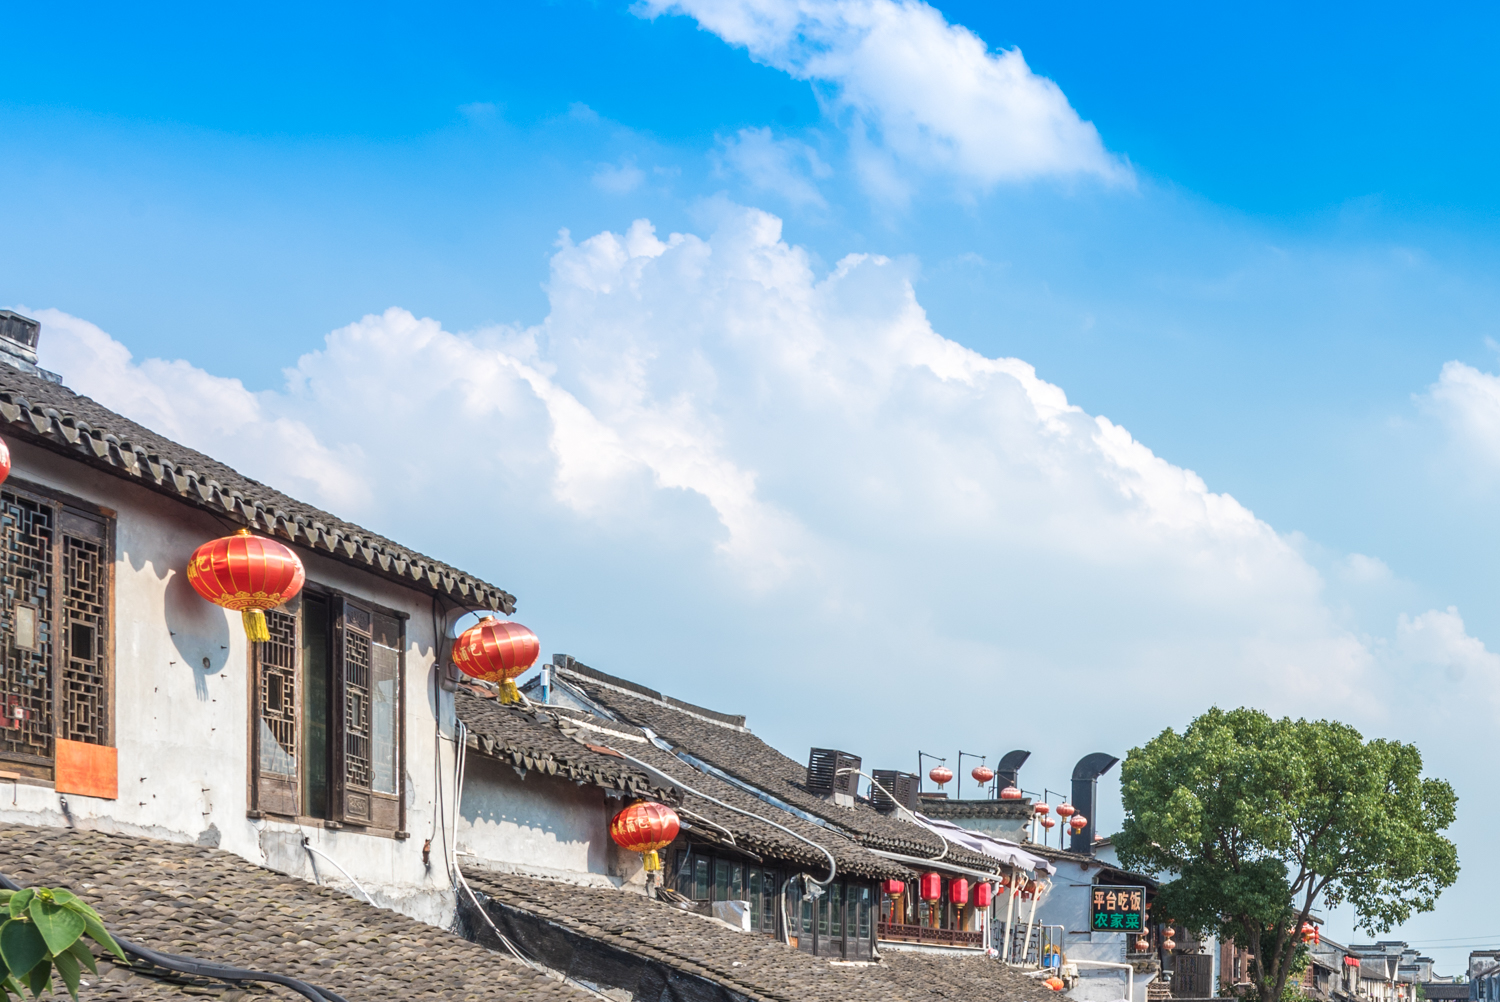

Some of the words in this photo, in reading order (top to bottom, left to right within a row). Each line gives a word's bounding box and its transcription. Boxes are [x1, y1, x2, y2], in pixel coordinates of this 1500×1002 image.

[1093, 890, 1141, 911] 平台吃饭
[1094, 912, 1139, 929] 农家菜
